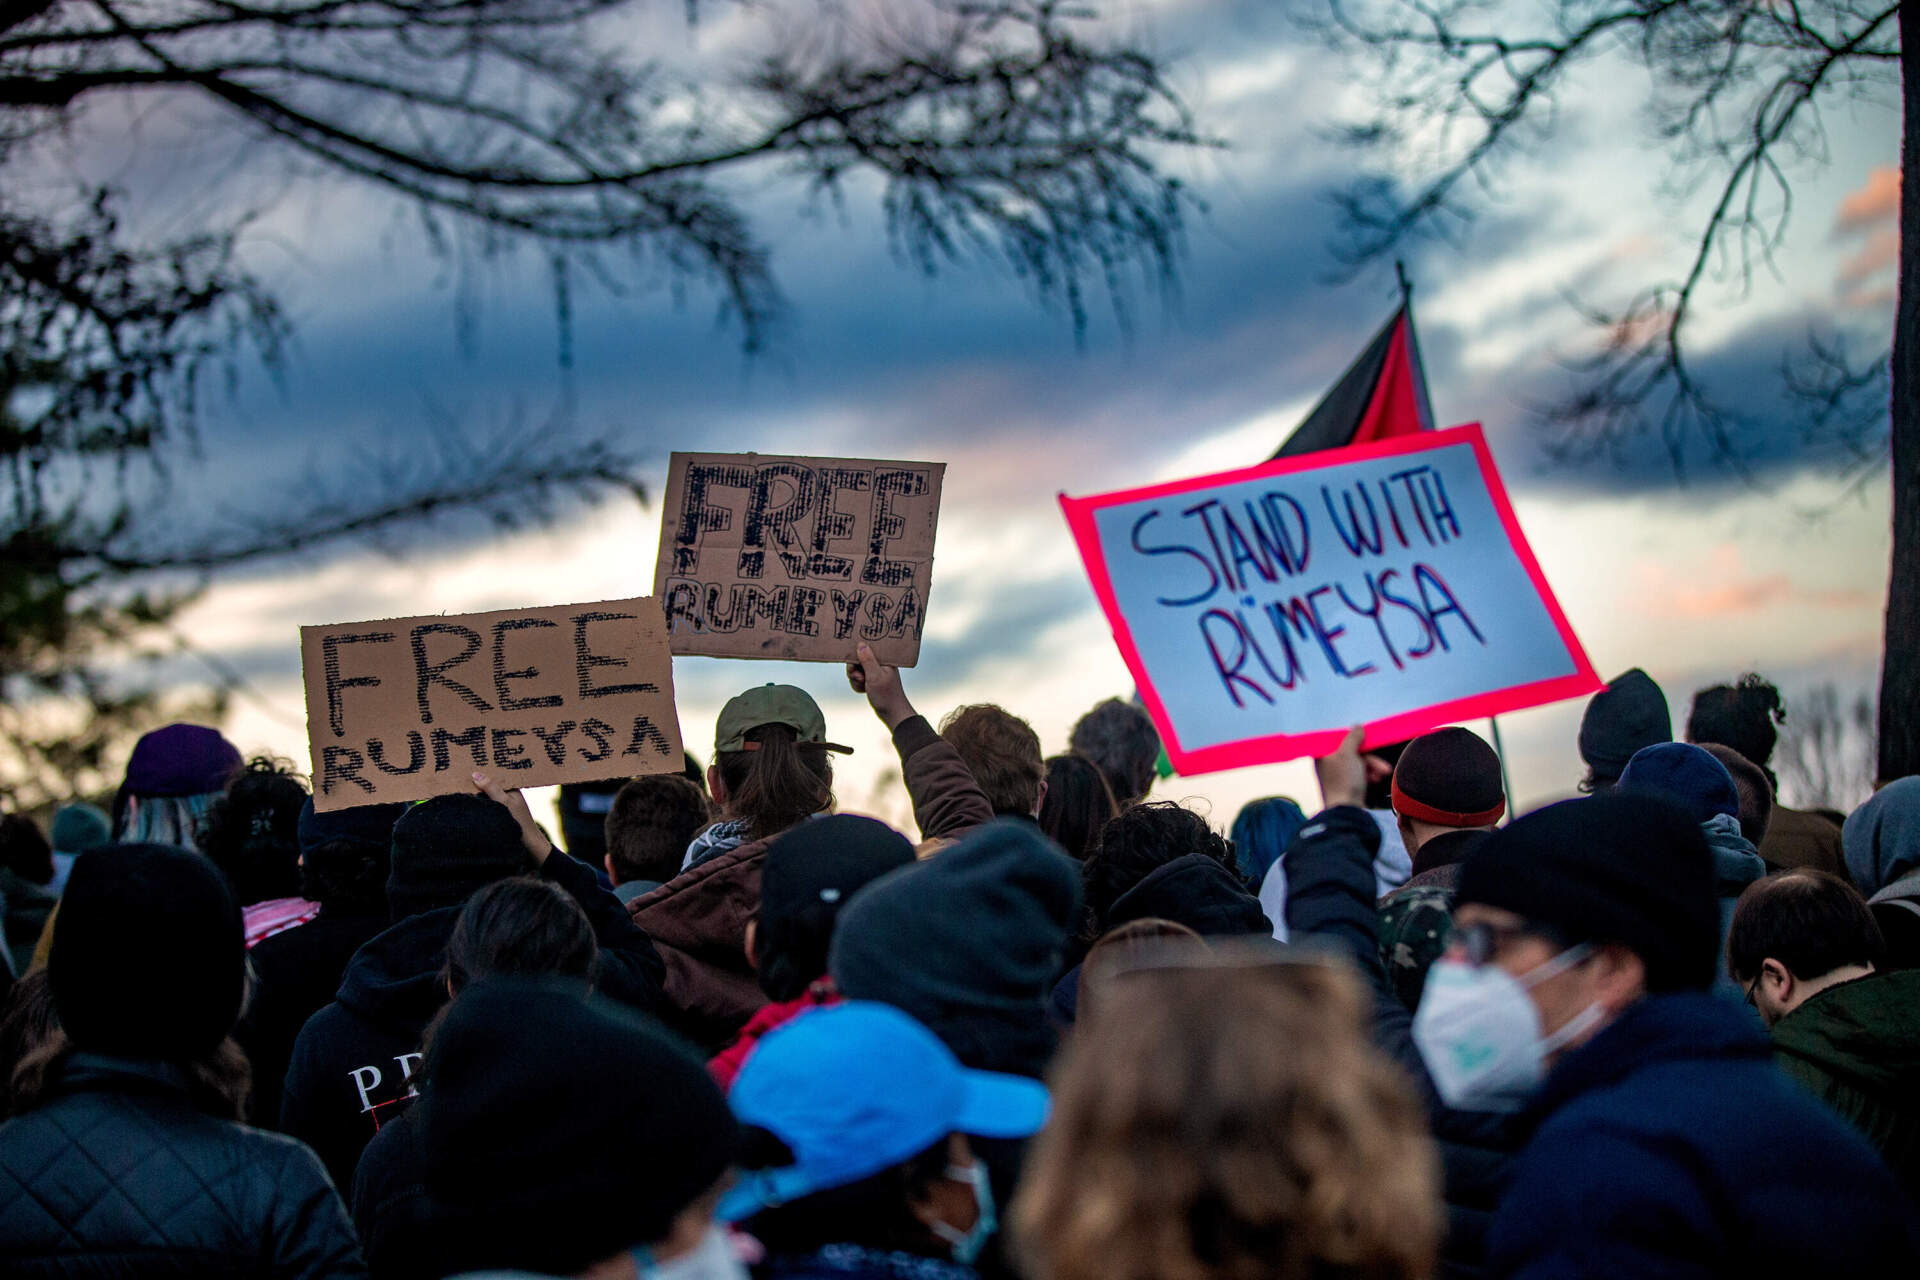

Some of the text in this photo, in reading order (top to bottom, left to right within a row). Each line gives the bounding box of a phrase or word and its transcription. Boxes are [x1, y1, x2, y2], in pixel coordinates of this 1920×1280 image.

[671, 461, 930, 588] FREE
[1131, 465, 1463, 606] STAND WITH
[664, 577, 924, 641] RUMEYSA
[323, 611, 660, 737] FREE
[322, 714, 671, 794] RUMEYSA
